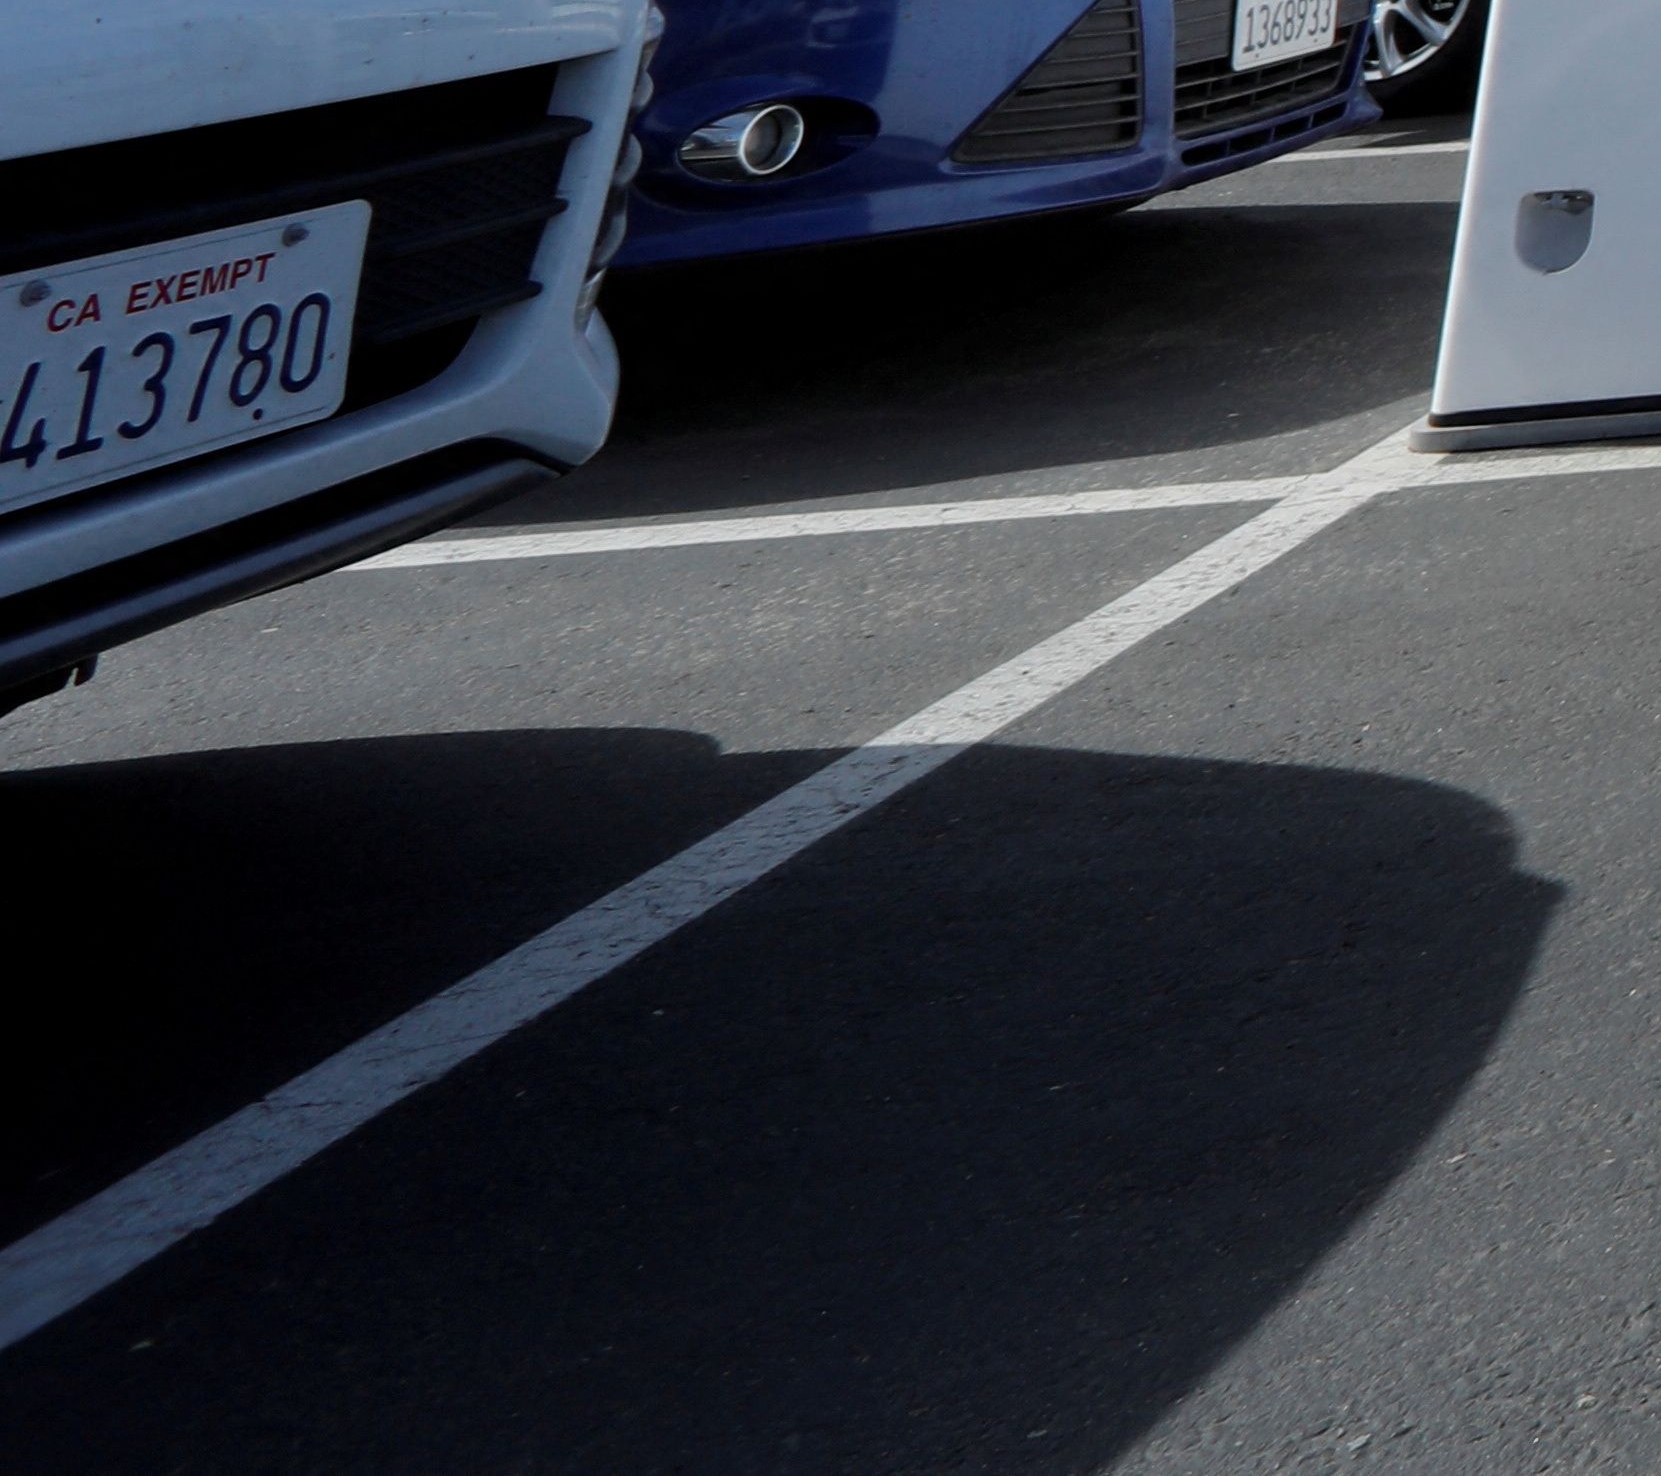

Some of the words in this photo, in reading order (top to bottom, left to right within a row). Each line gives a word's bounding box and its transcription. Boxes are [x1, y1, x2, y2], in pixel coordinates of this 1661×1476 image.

[47, 293, 101, 333] CA
[126, 252, 276, 314] EXEMPT
[0, 292, 331, 468] 413780
